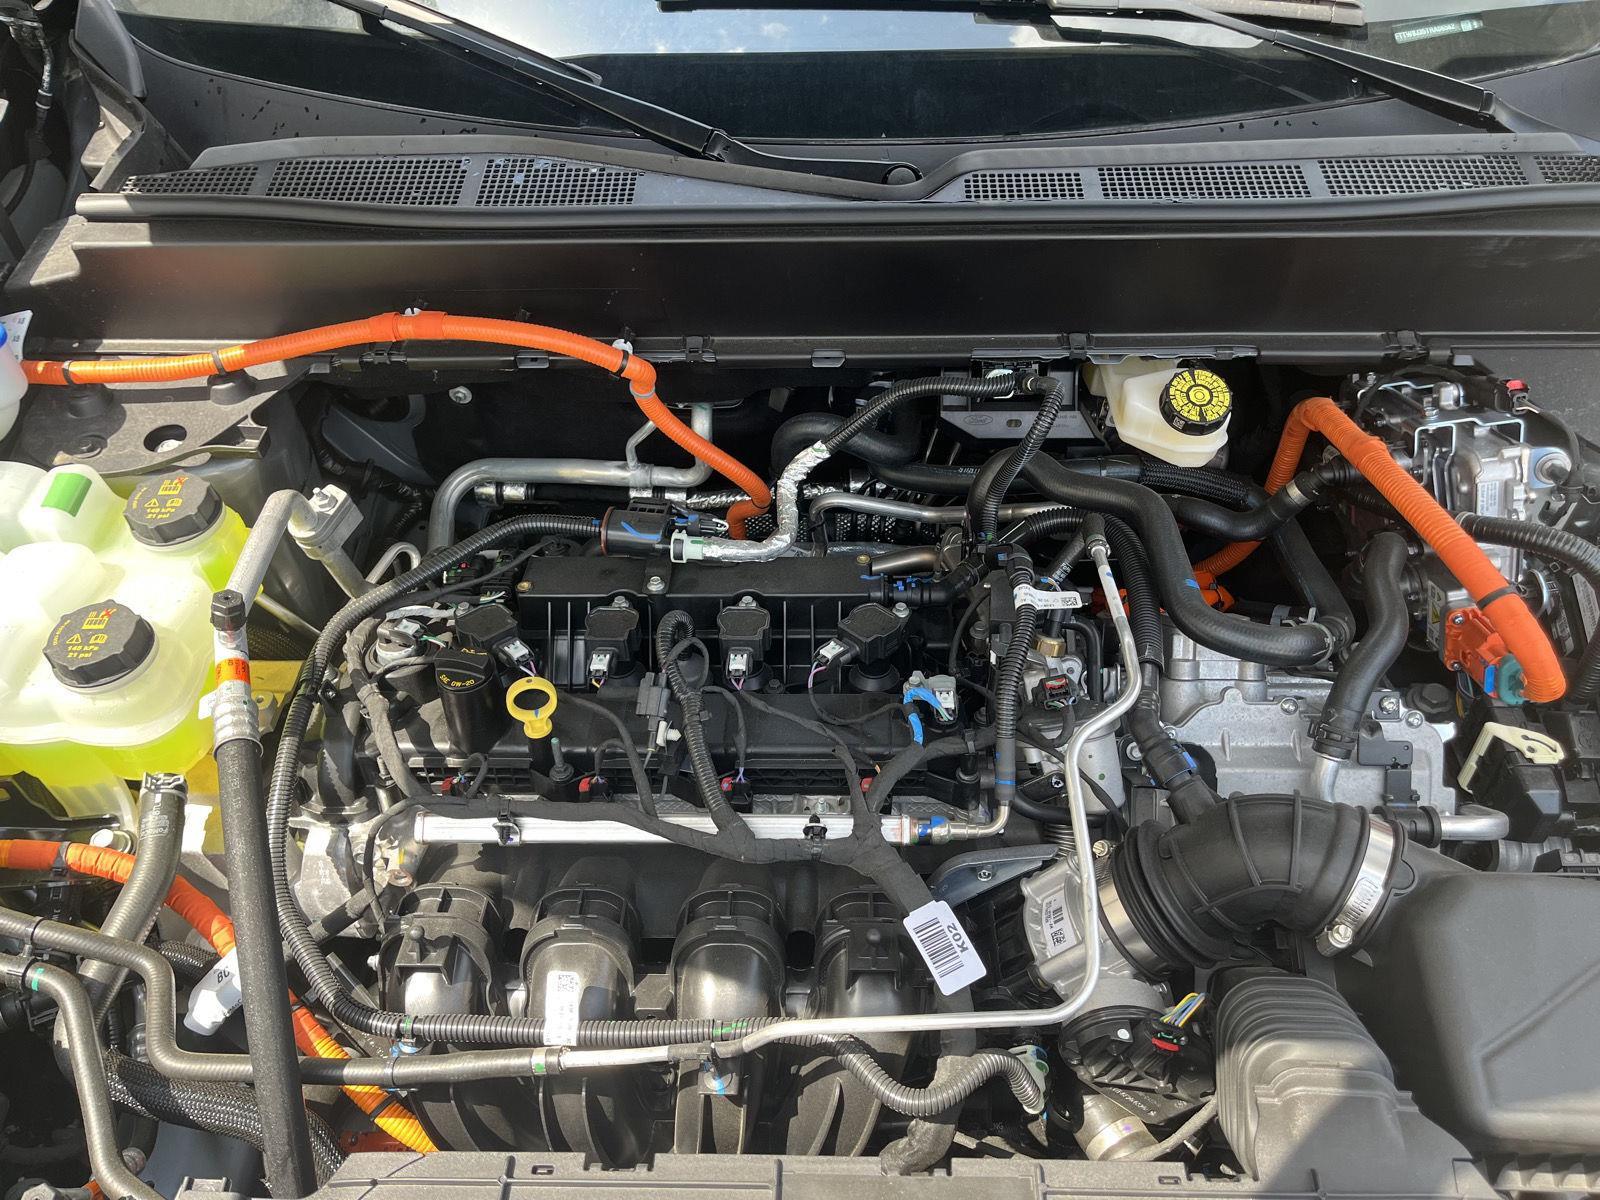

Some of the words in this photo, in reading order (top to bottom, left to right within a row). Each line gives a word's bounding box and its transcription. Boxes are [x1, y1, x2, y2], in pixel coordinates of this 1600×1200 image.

[440, 674, 450, 684] SAE
[451, 679, 475, 687] 0W-20
[947, 922, 969, 953] K02
